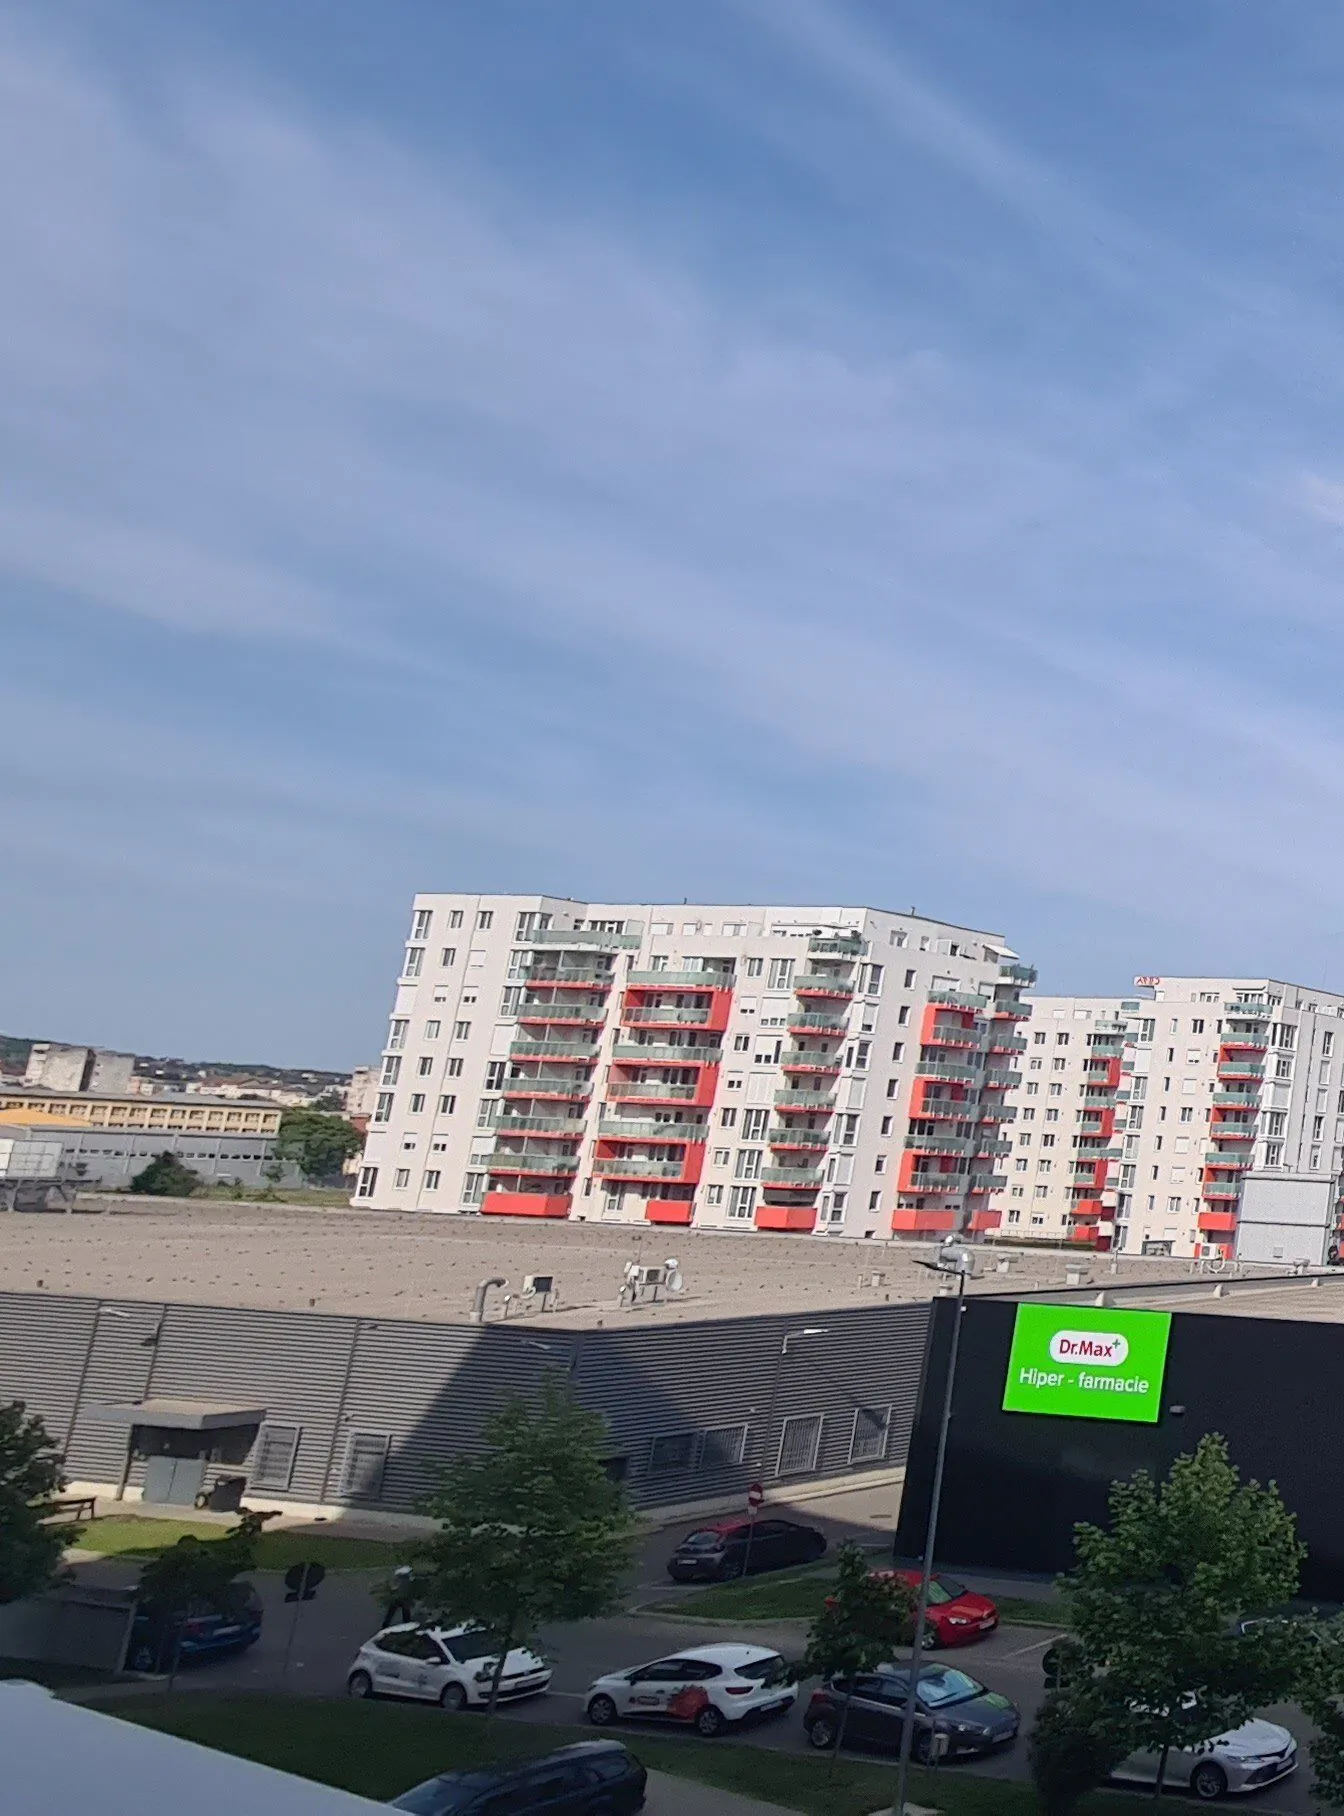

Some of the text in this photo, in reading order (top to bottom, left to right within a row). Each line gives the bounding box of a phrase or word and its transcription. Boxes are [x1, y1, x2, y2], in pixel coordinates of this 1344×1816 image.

[1059, 1339, 1112, 1357] Dr.Max
[1019, 1367, 1064, 1389] Hiper
[1079, 1371, 1149, 1393] farmacie
